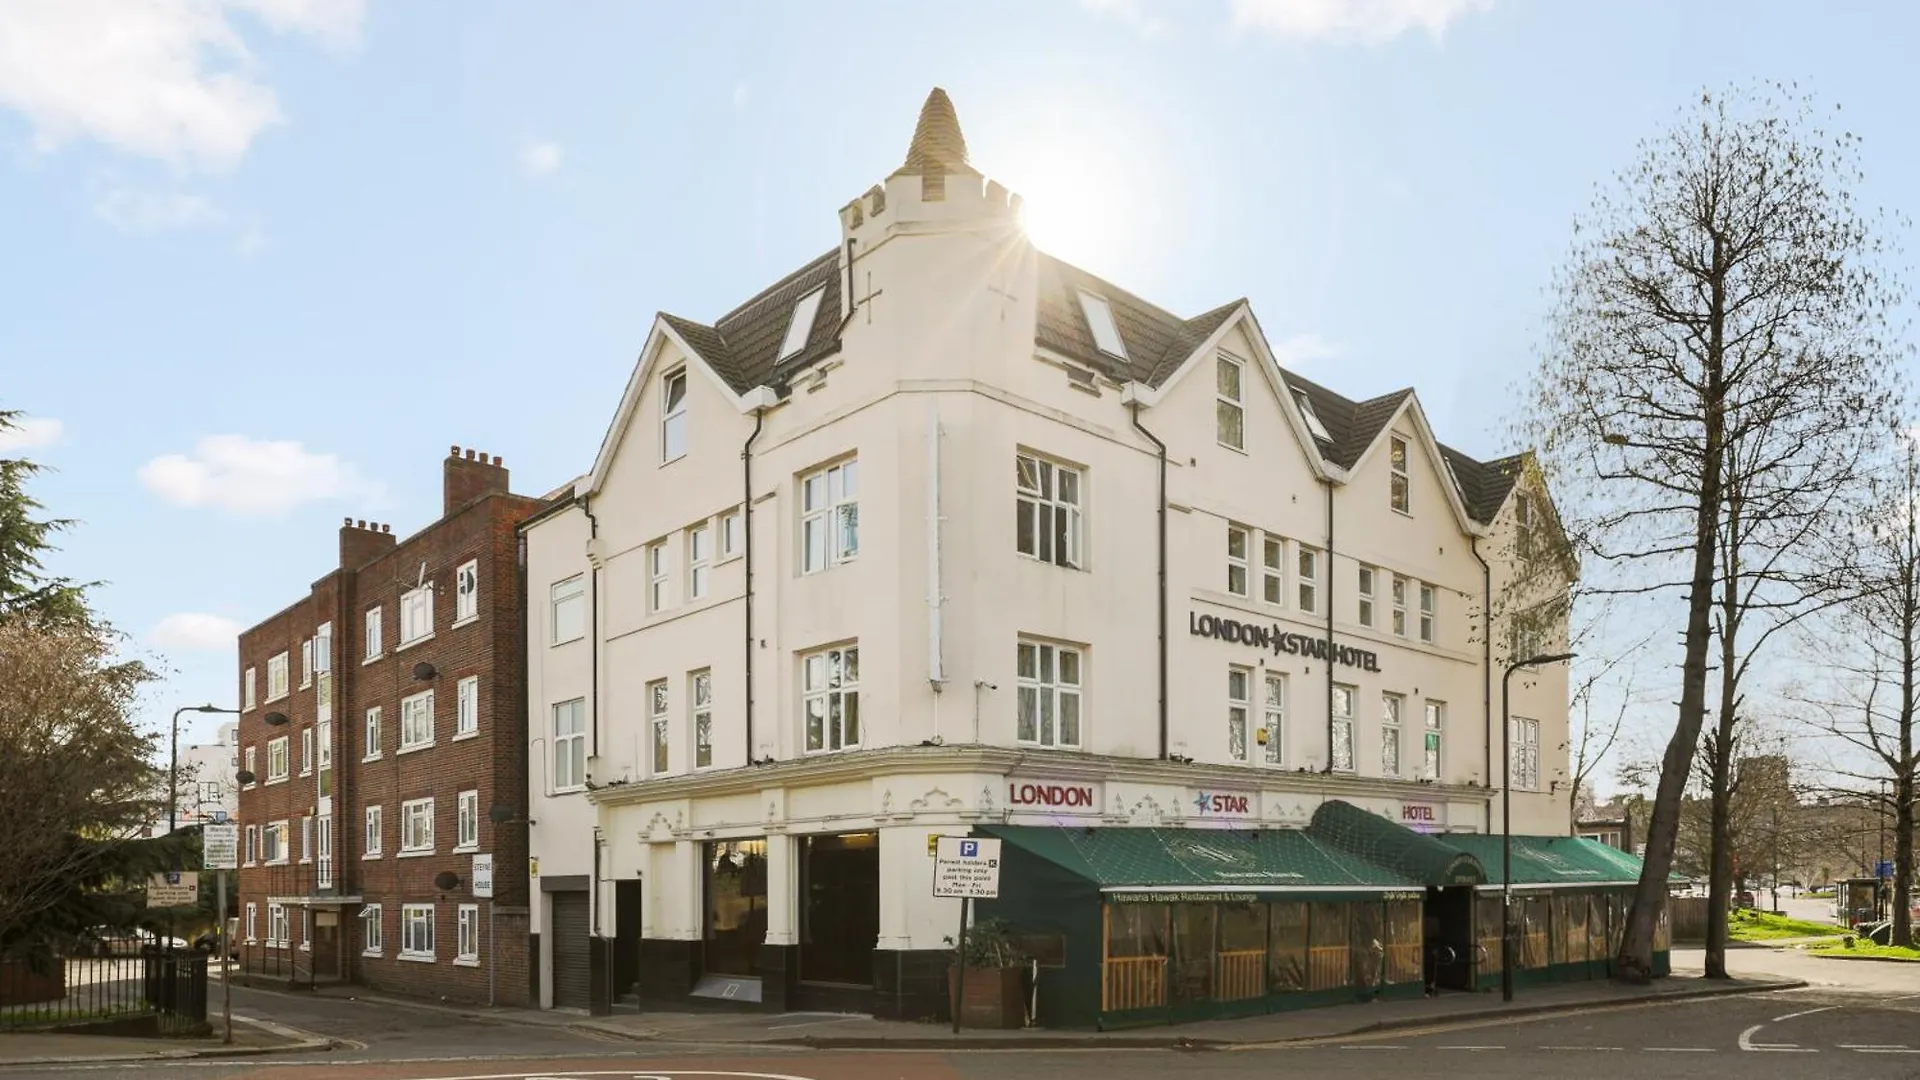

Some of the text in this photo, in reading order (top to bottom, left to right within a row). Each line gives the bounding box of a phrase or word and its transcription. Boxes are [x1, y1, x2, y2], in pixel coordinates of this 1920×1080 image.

[1190, 611, 1381, 673] LONDON STAR HOTEL
[1009, 783, 1092, 807] LONDON
[1213, 795, 1249, 814] STAR
[1403, 805, 1436, 820] HOTEL
[963, 842, 975, 855] P
